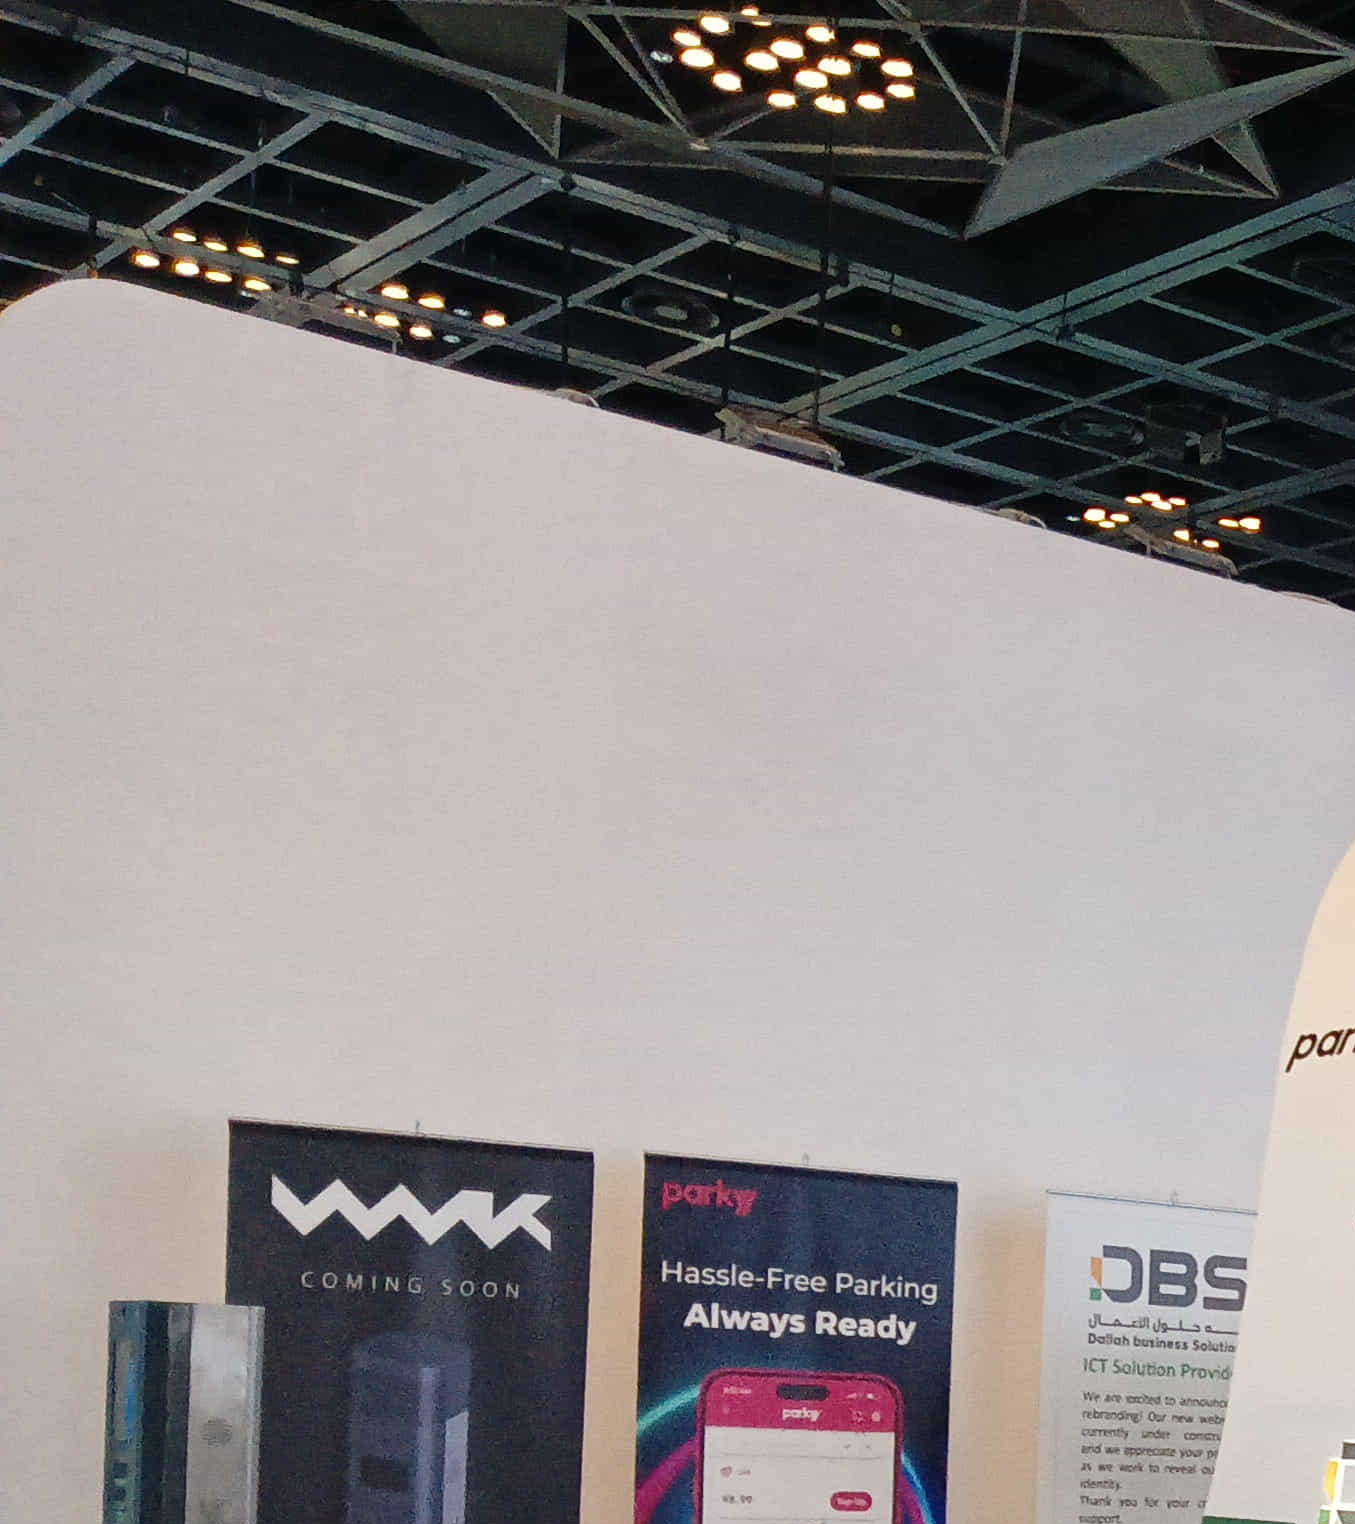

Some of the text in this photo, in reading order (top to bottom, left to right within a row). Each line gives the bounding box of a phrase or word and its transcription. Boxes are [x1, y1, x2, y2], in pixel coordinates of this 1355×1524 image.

[661, 1179, 758, 1216] parky
[301, 1271, 521, 1299] COMING SOON
[661, 1260, 938, 1305] Hassle-Free Parking
[1090, 1245, 1247, 1312] DBS
[683, 1302, 917, 1345] Always Ready
[1088, 1333, 1236, 1353] Dallah business Solutio
[1083, 1358, 1232, 1380] ICT Solution Provid
[1179, 1398, 1228, 1408] announc
[1201, 1467, 1214, 1475] ou
